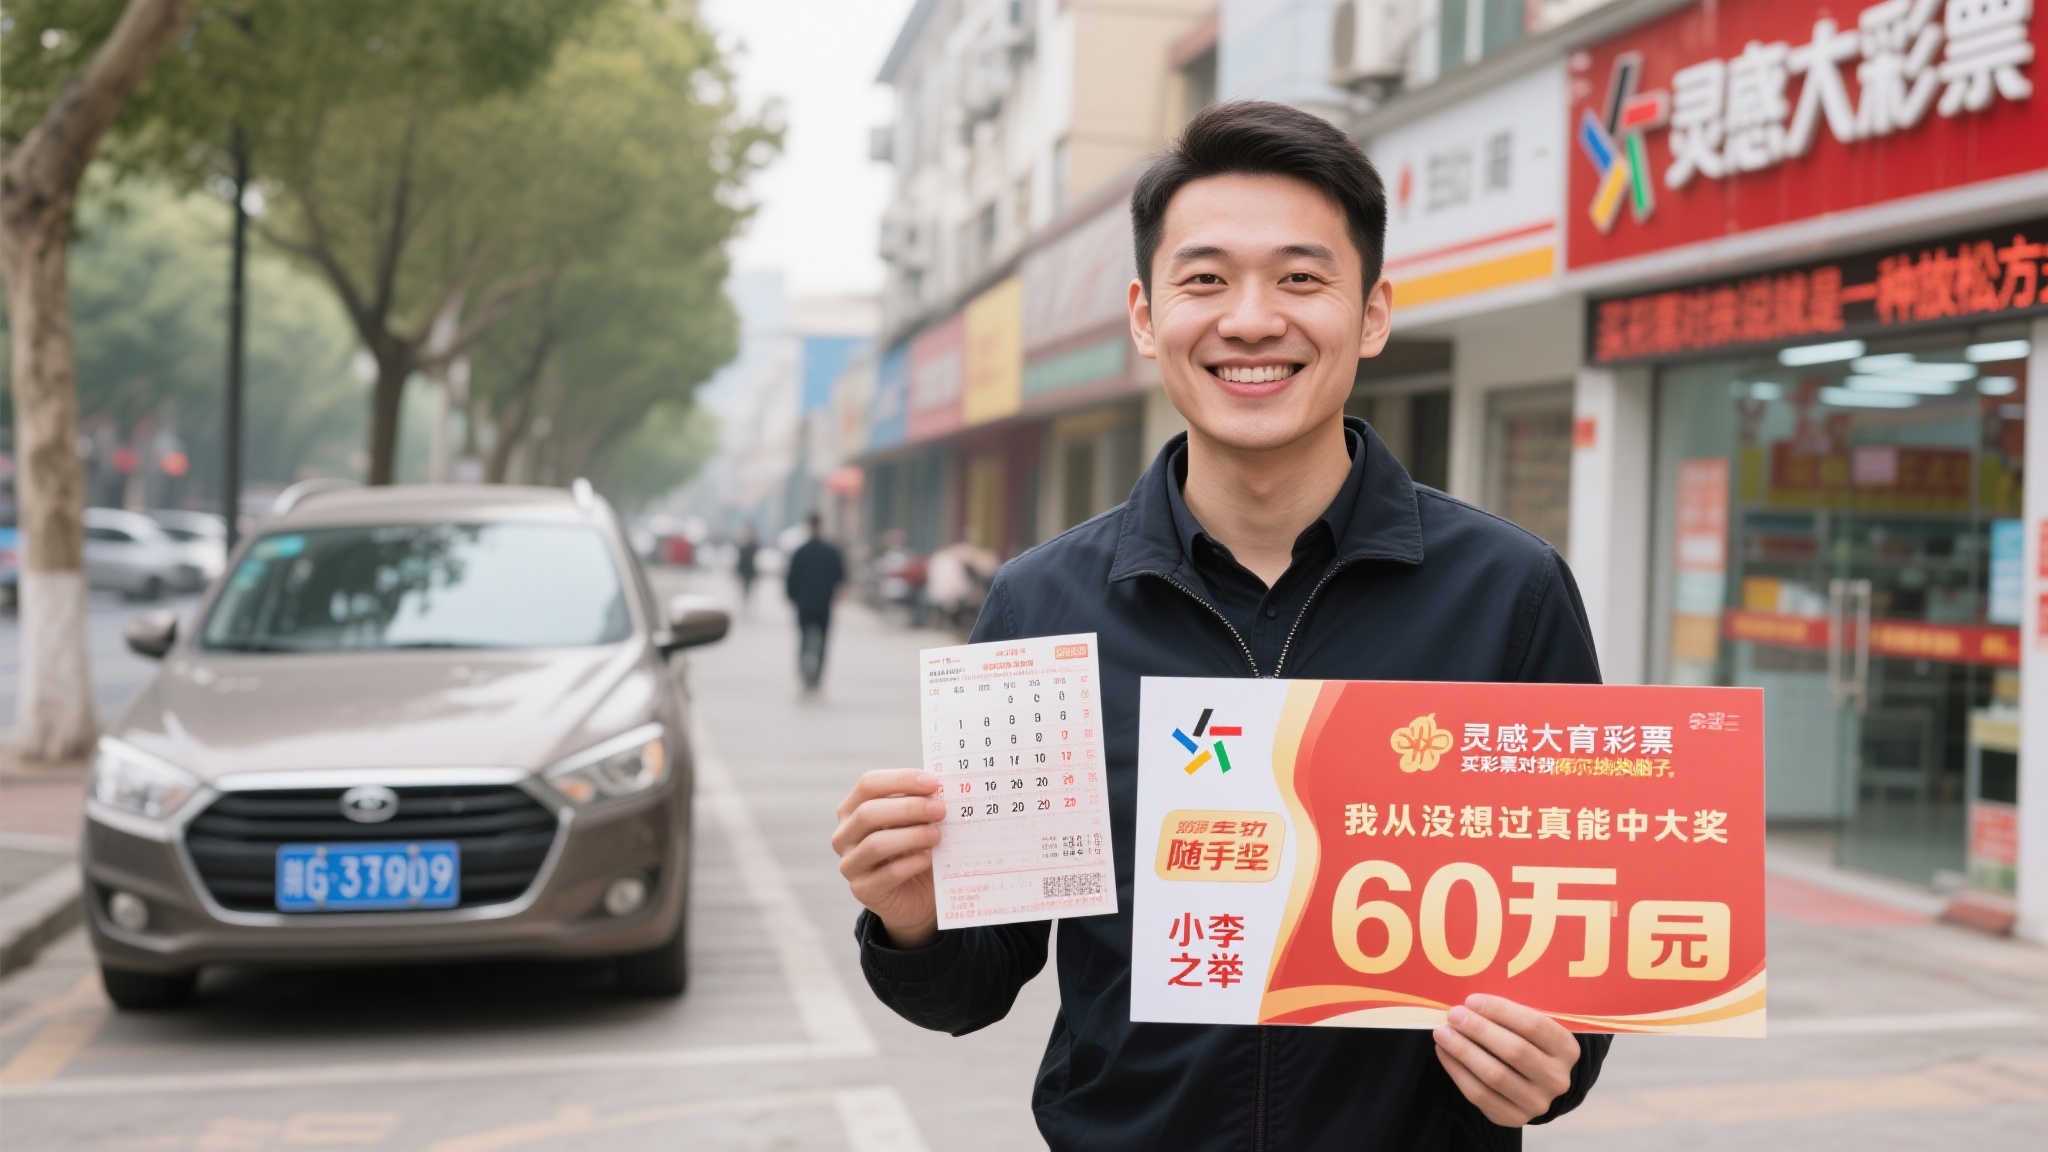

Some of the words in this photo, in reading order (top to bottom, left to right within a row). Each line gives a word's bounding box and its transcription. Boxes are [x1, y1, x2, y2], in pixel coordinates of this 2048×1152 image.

[1460, 722, 1673, 755] 灵感大育彩票
[1344, 802, 1729, 844] 我从没想过真能中大奖
[1168, 912, 1245, 949] 小李
[1167, 952, 1244, 989] 之举
